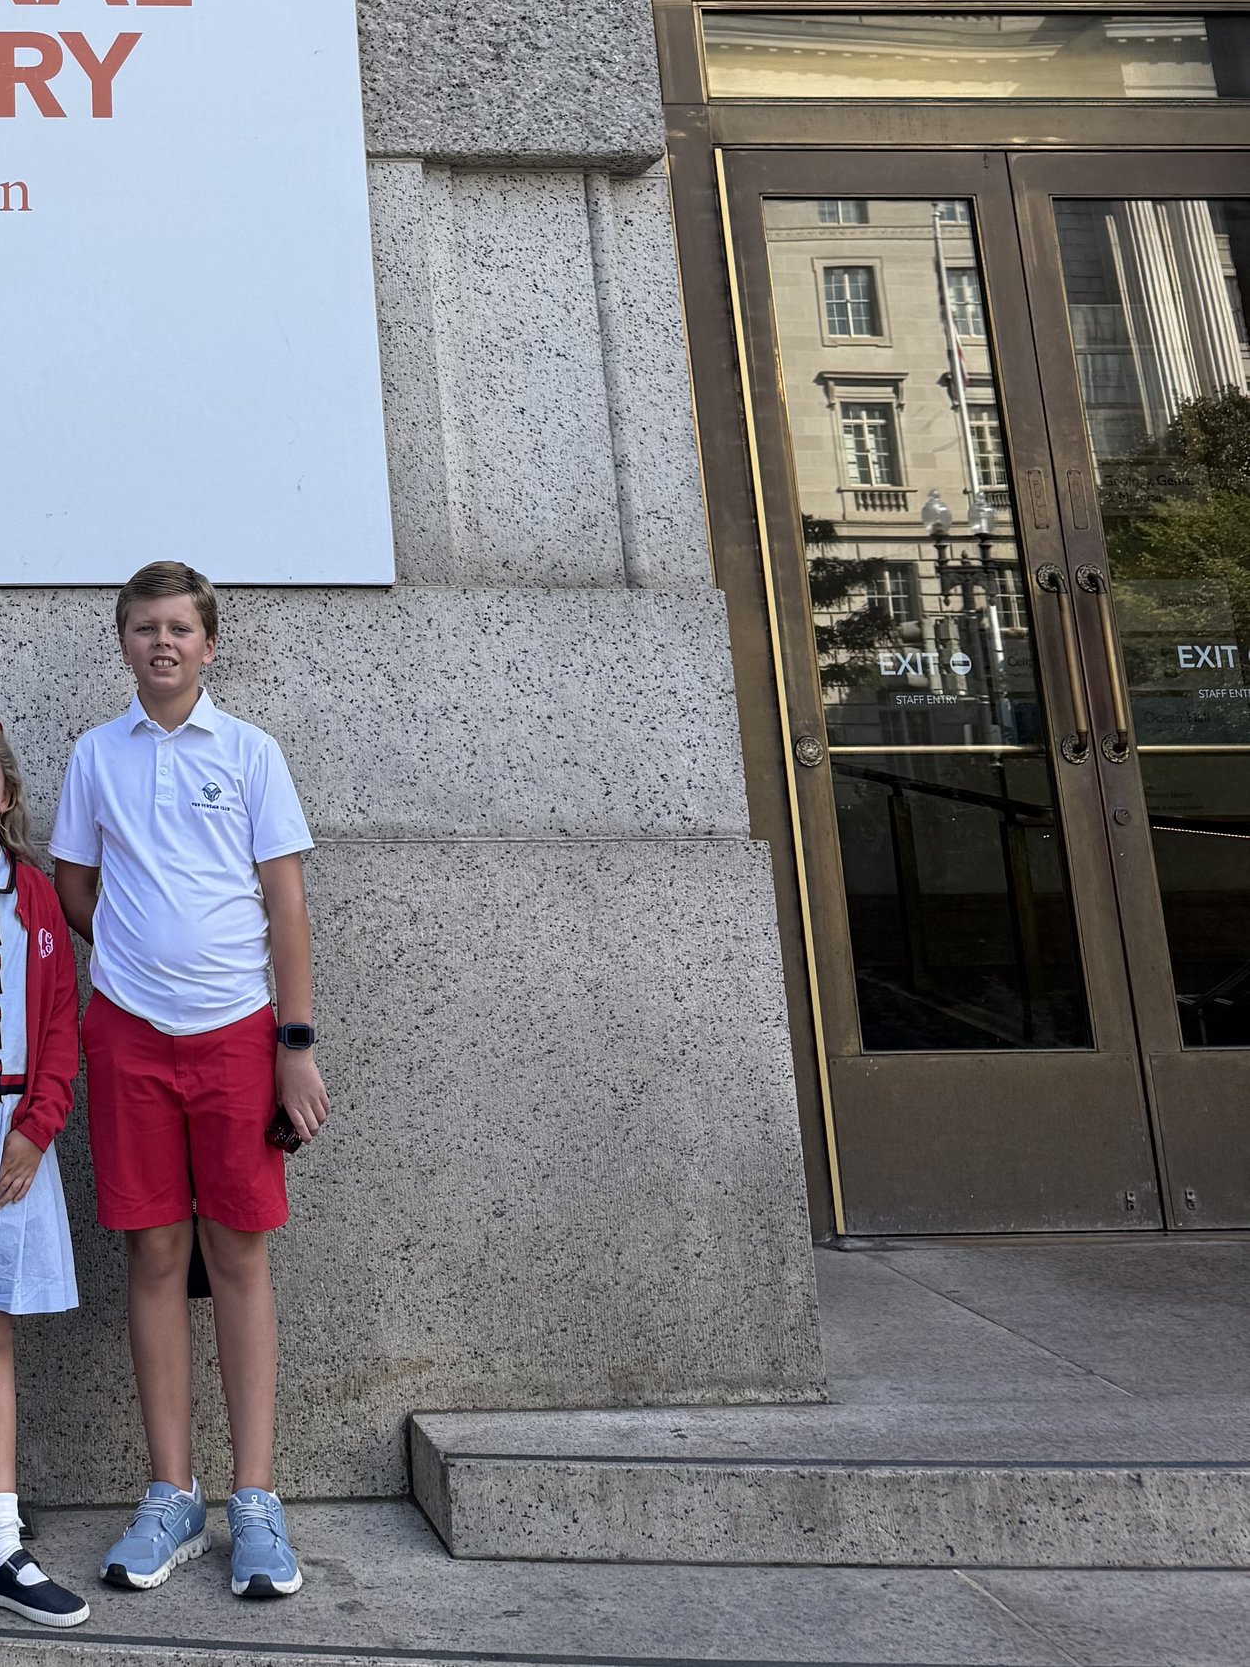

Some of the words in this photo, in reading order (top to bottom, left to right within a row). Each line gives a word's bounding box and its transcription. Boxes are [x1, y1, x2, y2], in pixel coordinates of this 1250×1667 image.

[878, 652, 940, 676] EXIT
[1177, 645, 1238, 669] EXIT
[895, 695, 925, 705] STAFF
[926, 694, 958, 705] ENTRY
[1198, 688, 1227, 699] STAFF
